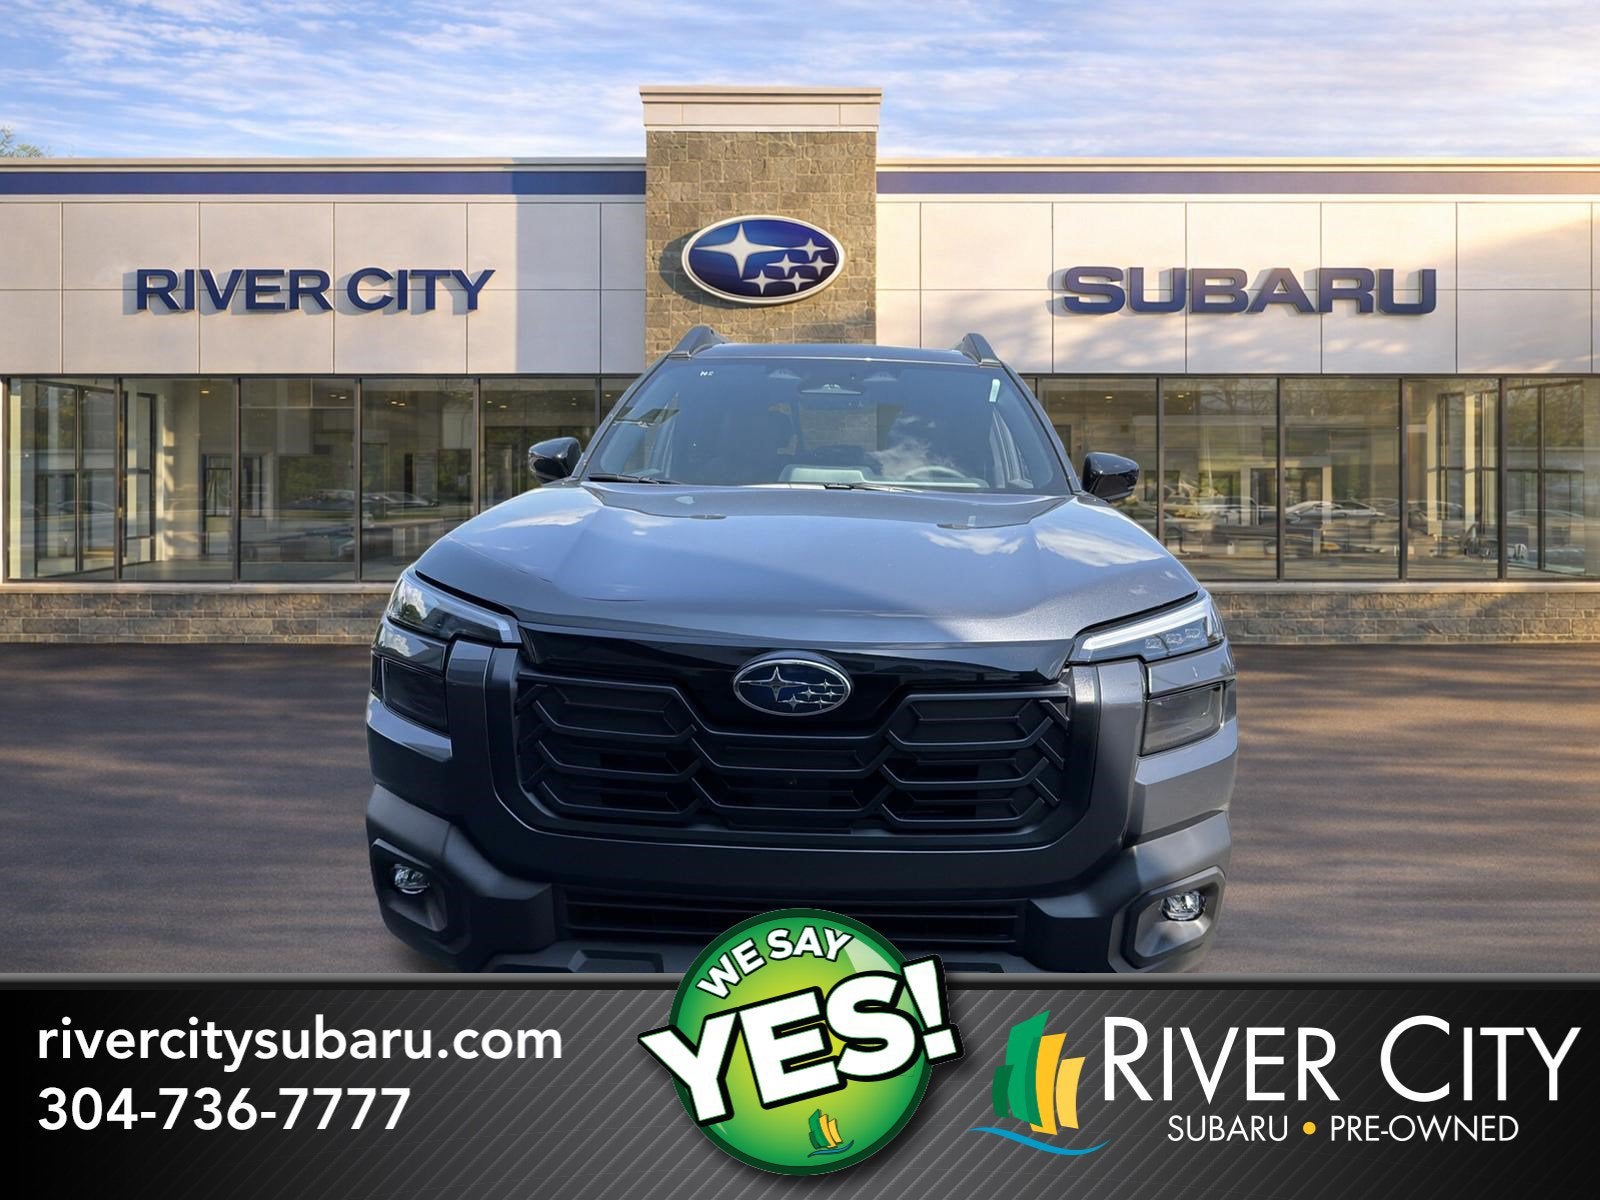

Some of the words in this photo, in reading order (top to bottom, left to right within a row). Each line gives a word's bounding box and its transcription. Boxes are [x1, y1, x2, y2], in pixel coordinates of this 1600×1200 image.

[136, 268, 333, 311] RIVER
[347, 266, 496, 312] CITY
[1062, 265, 1437, 315] SUBARU
